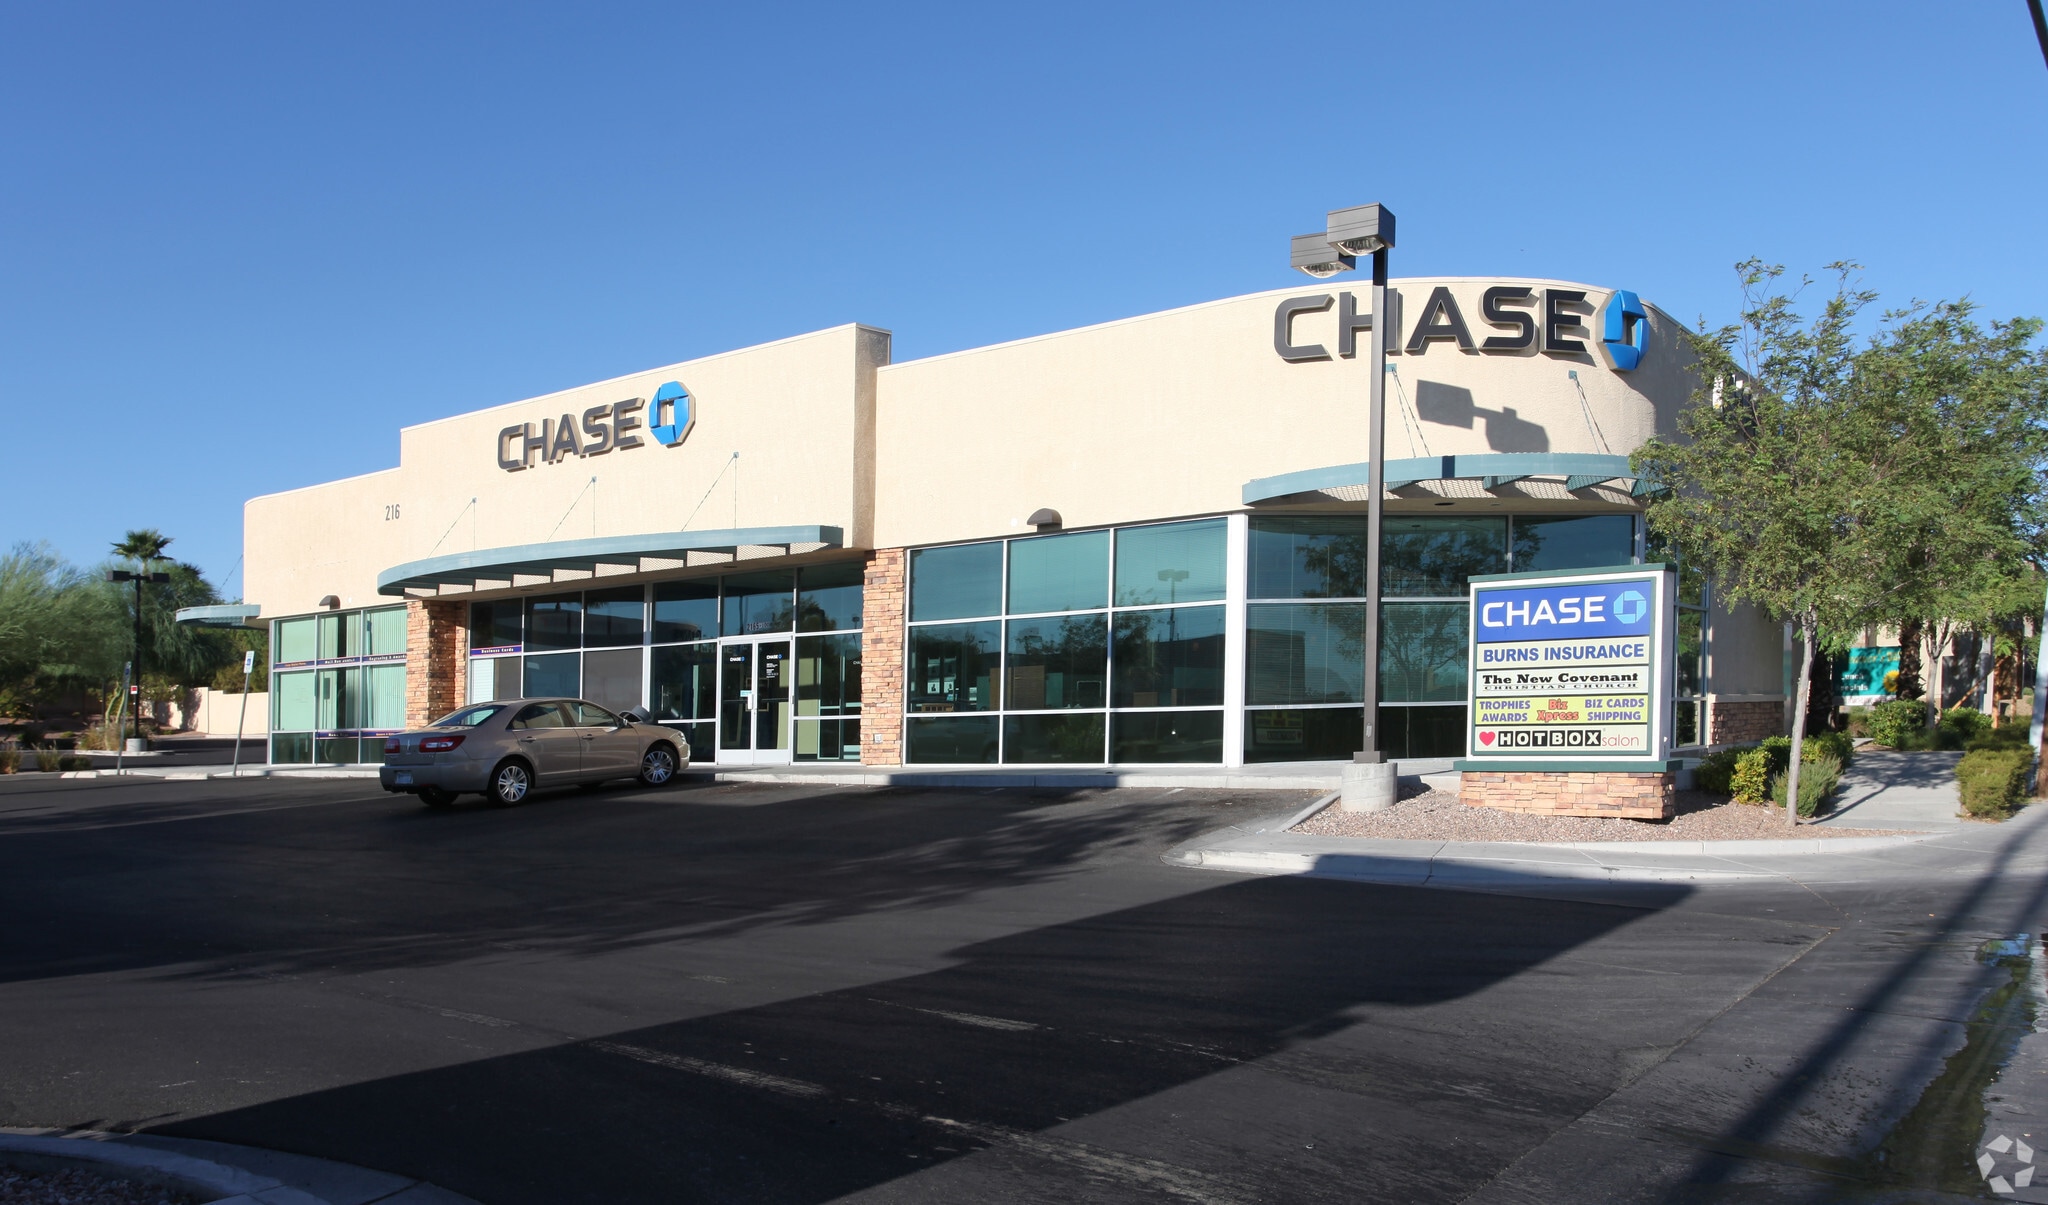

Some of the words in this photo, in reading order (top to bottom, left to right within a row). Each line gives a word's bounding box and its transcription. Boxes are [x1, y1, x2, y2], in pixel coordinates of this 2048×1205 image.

[1274, 286, 1592, 361] CHASE
[497, 397, 645, 472] CHASE
[1482, 595, 1606, 628] CHASE
[1483, 647, 1539, 663] BURNS
[1544, 643, 1645, 661] INSURANCE
[1482, 675, 1512, 684] The
[1517, 674, 1553, 683] New
[1558, 672, 1639, 682] Covenant
[1480, 700, 1531, 710] TROPHIES
[1548, 698, 1568, 710] Biz
[1584, 699, 1603, 709] BIZ
[1606, 698, 1645, 708] CARDS
[1481, 712, 1528, 722] AWARDS
[1536, 709, 1579, 723] Xpress
[1587, 711, 1641, 721] SHIPPING
[1498, 730, 1601, 747] HOTBOX
[1601, 734, 1640, 747] salon
